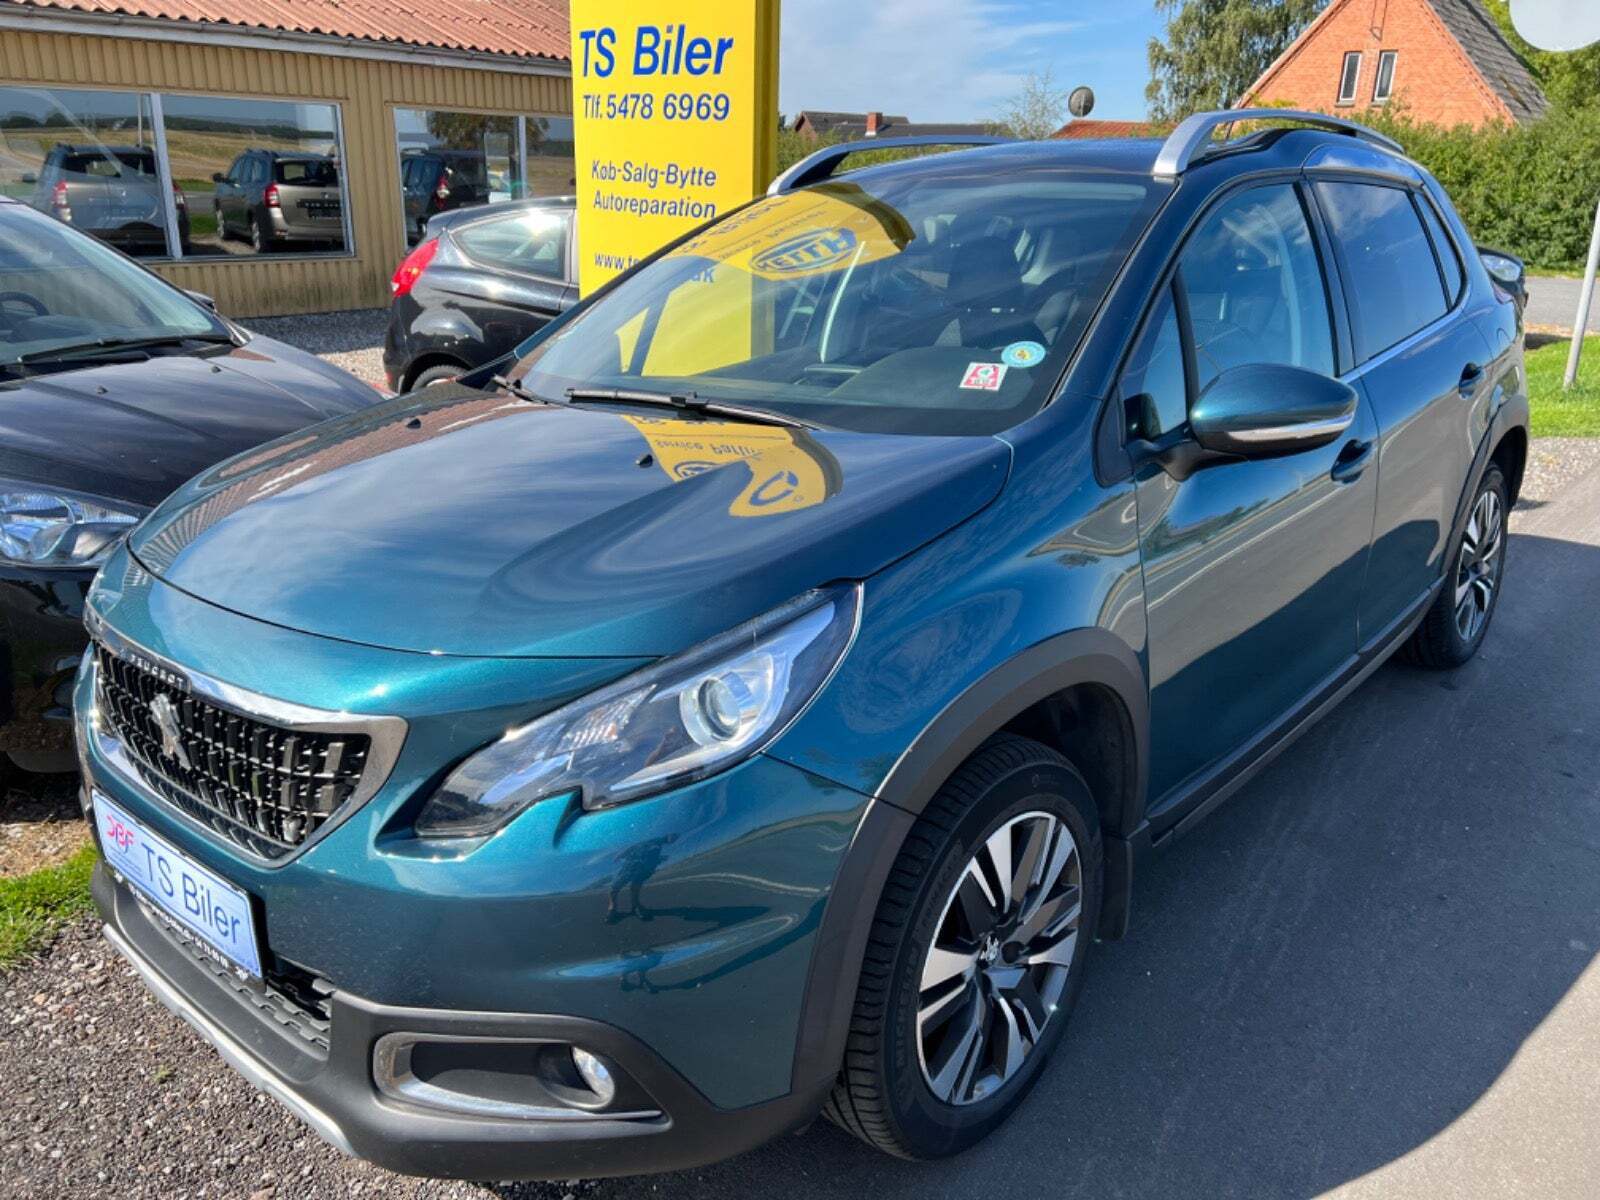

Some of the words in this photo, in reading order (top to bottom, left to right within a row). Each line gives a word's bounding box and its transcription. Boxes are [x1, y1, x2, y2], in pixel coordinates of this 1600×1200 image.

[579, 27, 617, 77] TS
[632, 24, 734, 76] Biler
[583, 94, 603, 119] Tlf.
[606, 93, 653, 119] 5478
[663, 93, 730, 120] 6969
[593, 189, 717, 218] Autoreparation
[128, 653, 184, 691] PEUGEOT
[140, 842, 175, 898] TS
[182, 871, 241, 945] Biler
